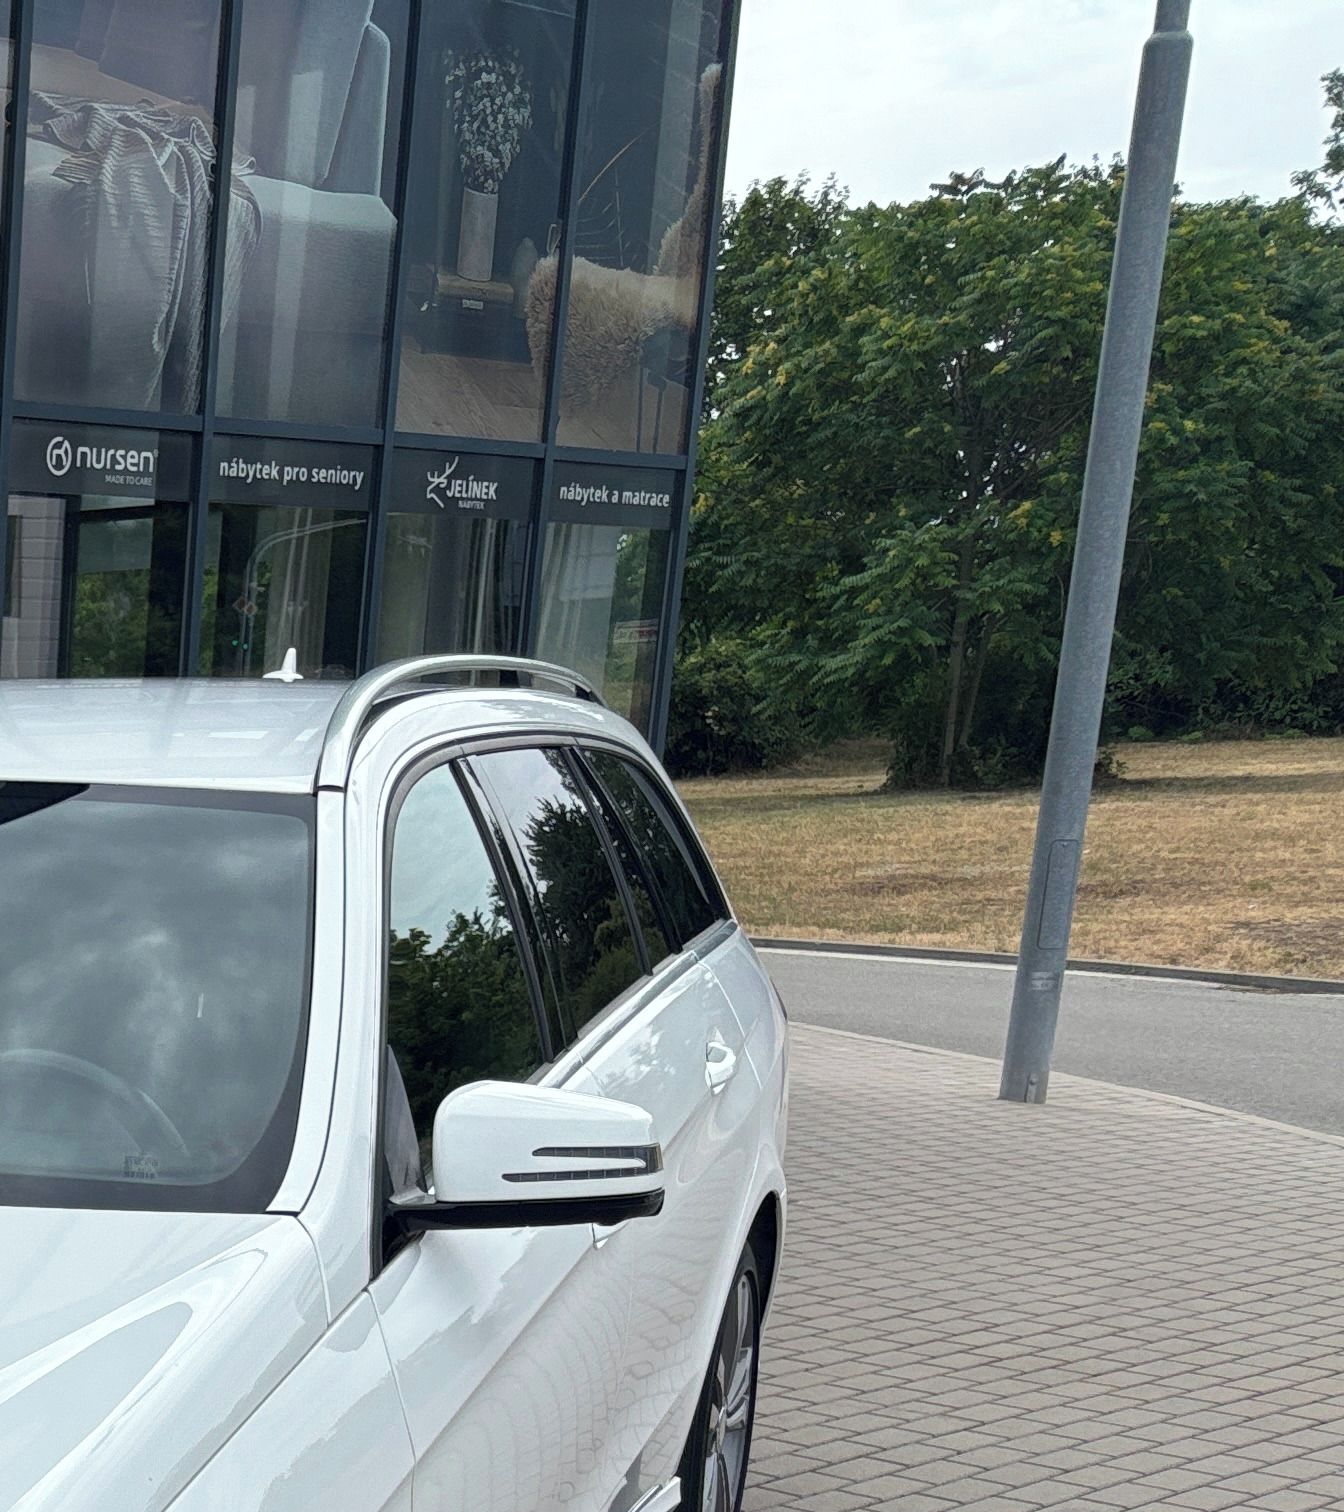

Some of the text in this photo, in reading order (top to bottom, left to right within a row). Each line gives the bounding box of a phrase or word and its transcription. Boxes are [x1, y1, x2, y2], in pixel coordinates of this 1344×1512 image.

[76, 445, 155, 473] nursen
[104, 474, 125, 485] MADE
[135, 475, 153, 487] CARE
[219, 457, 364, 490] nábytek pro seniory
[446, 475, 498, 500] JELÍNEK
[559, 482, 670, 508] nábytek a matrace
[458, 500, 485, 510] NÁBYTEK
